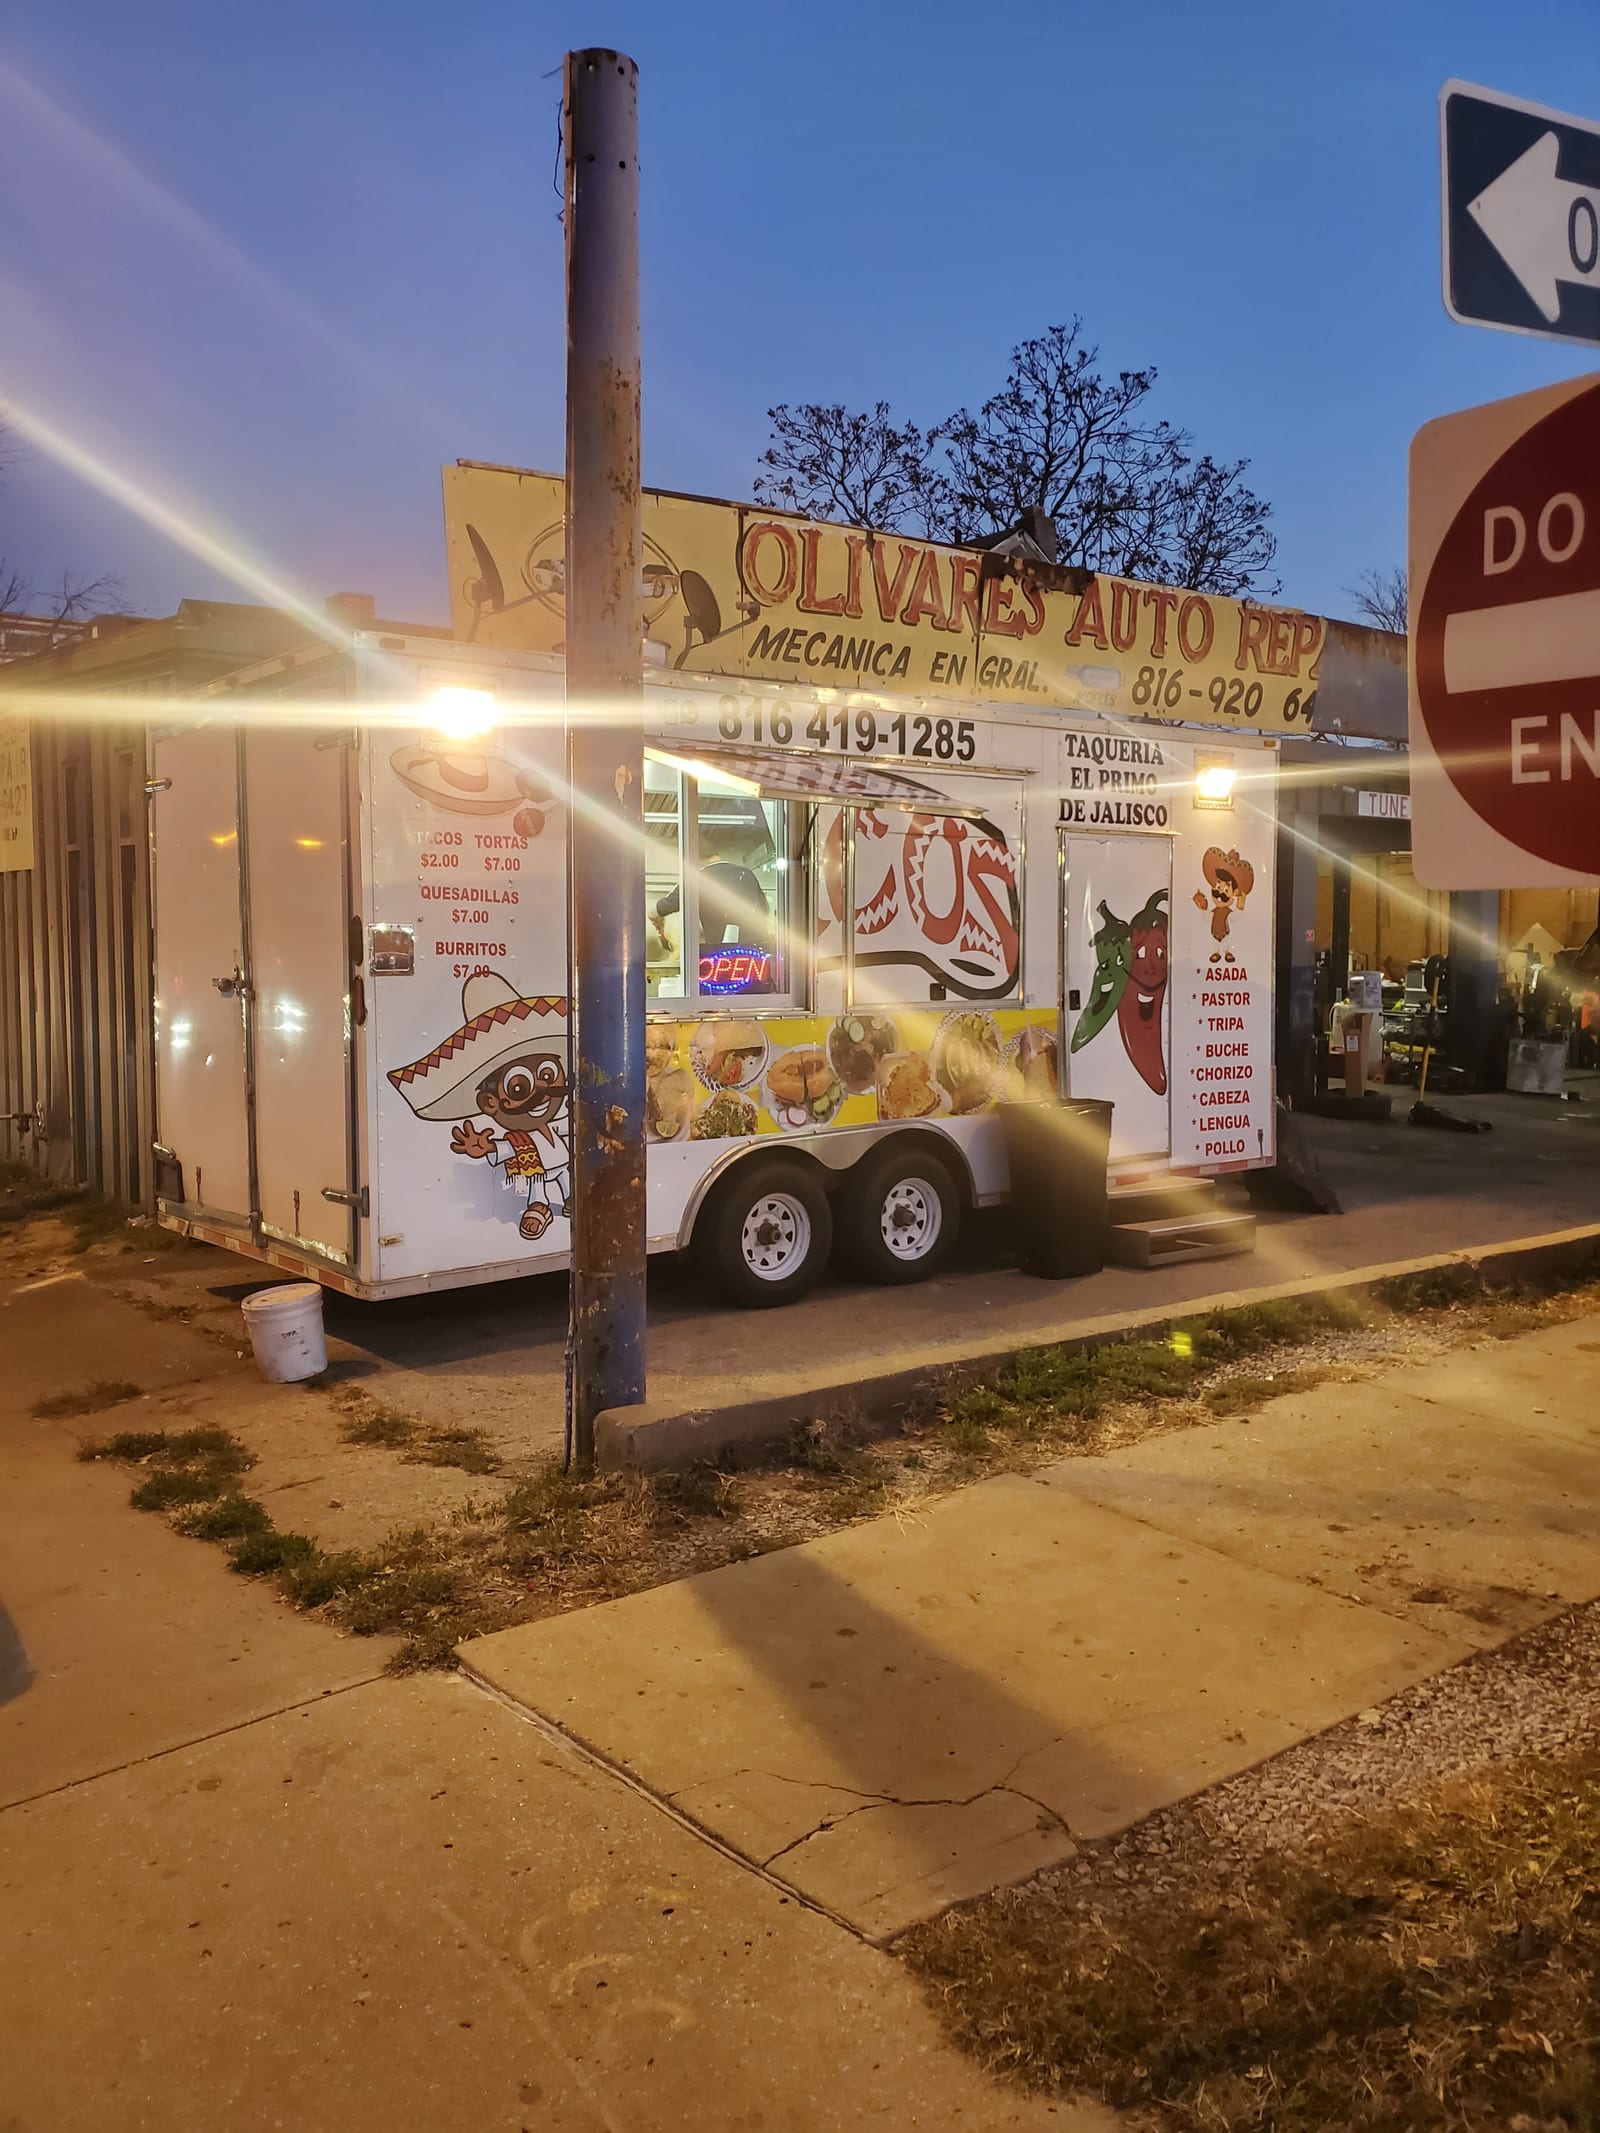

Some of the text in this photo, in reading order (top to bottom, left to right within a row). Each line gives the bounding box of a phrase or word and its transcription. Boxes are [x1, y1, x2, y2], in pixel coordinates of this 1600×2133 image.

[1484, 492, 1585, 576] DO
[736, 521, 1322, 680] OLIVARES AUTO REP
[748, 624, 1048, 694] MECANICA EN GRAL.
[1131, 665, 1317, 724] 816-920 64
[718, 694, 975, 761] 816 419-1285
[1065, 733, 1164, 766] TAQUERIA
[1511, 709, 1600, 784] EN
[1070, 767, 1158, 796] EL PRIMO
[1059, 798, 1168, 827] DE JALISCO
[1369, 792, 1409, 818] TUNE
[474, 834, 528, 850] TORTAS
[421, 853, 521, 872] $2.00 $7.00
[421, 885, 519, 904] QUESADILLAS
[452, 908, 489, 924] $7.00
[435, 941, 507, 957] BURRITOS
[698, 957, 767, 982] OPEN
[1205, 967, 1247, 982] ASADA
[1202, 992, 1250, 1006] PASTOR
[1207, 1017, 1244, 1031] TRIPA
[1205, 1043, 1249, 1057] BUCHE
[1196, 1065, 1253, 1081] CHORIZO
[1200, 1090, 1250, 1106] CABEZA
[1200, 1115, 1250, 1131] LENGUA
[1205, 1139, 1245, 1156] POLLO
